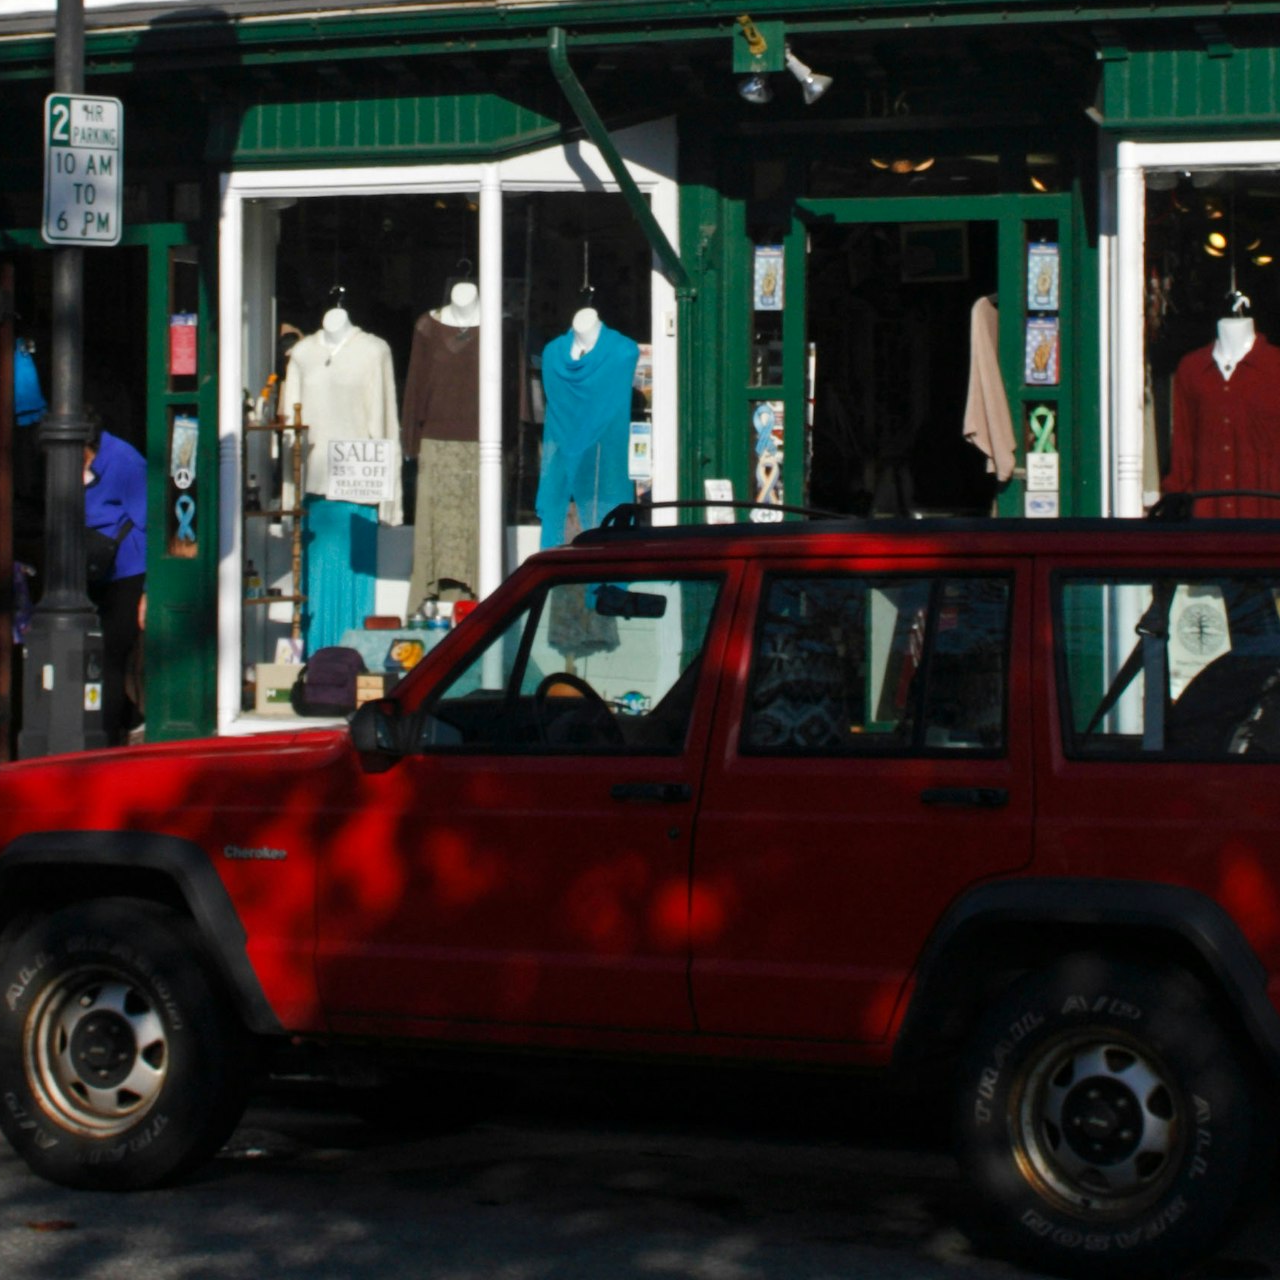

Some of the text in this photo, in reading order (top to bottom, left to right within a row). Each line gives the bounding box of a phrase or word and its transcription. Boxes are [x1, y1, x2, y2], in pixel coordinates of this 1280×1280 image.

[52, 104, 103, 140] 2 HR
[73, 126, 116, 145] PARKING
[56, 153, 112, 176] 10 AM
[73, 183, 96, 205] TO
[56, 210, 110, 233] 6 PM
[333, 442, 385, 462] SALE
[361, 465, 386, 477] OFF
[335, 479, 383, 488] SELECTED
[223, 844, 288, 860] Cherokee
